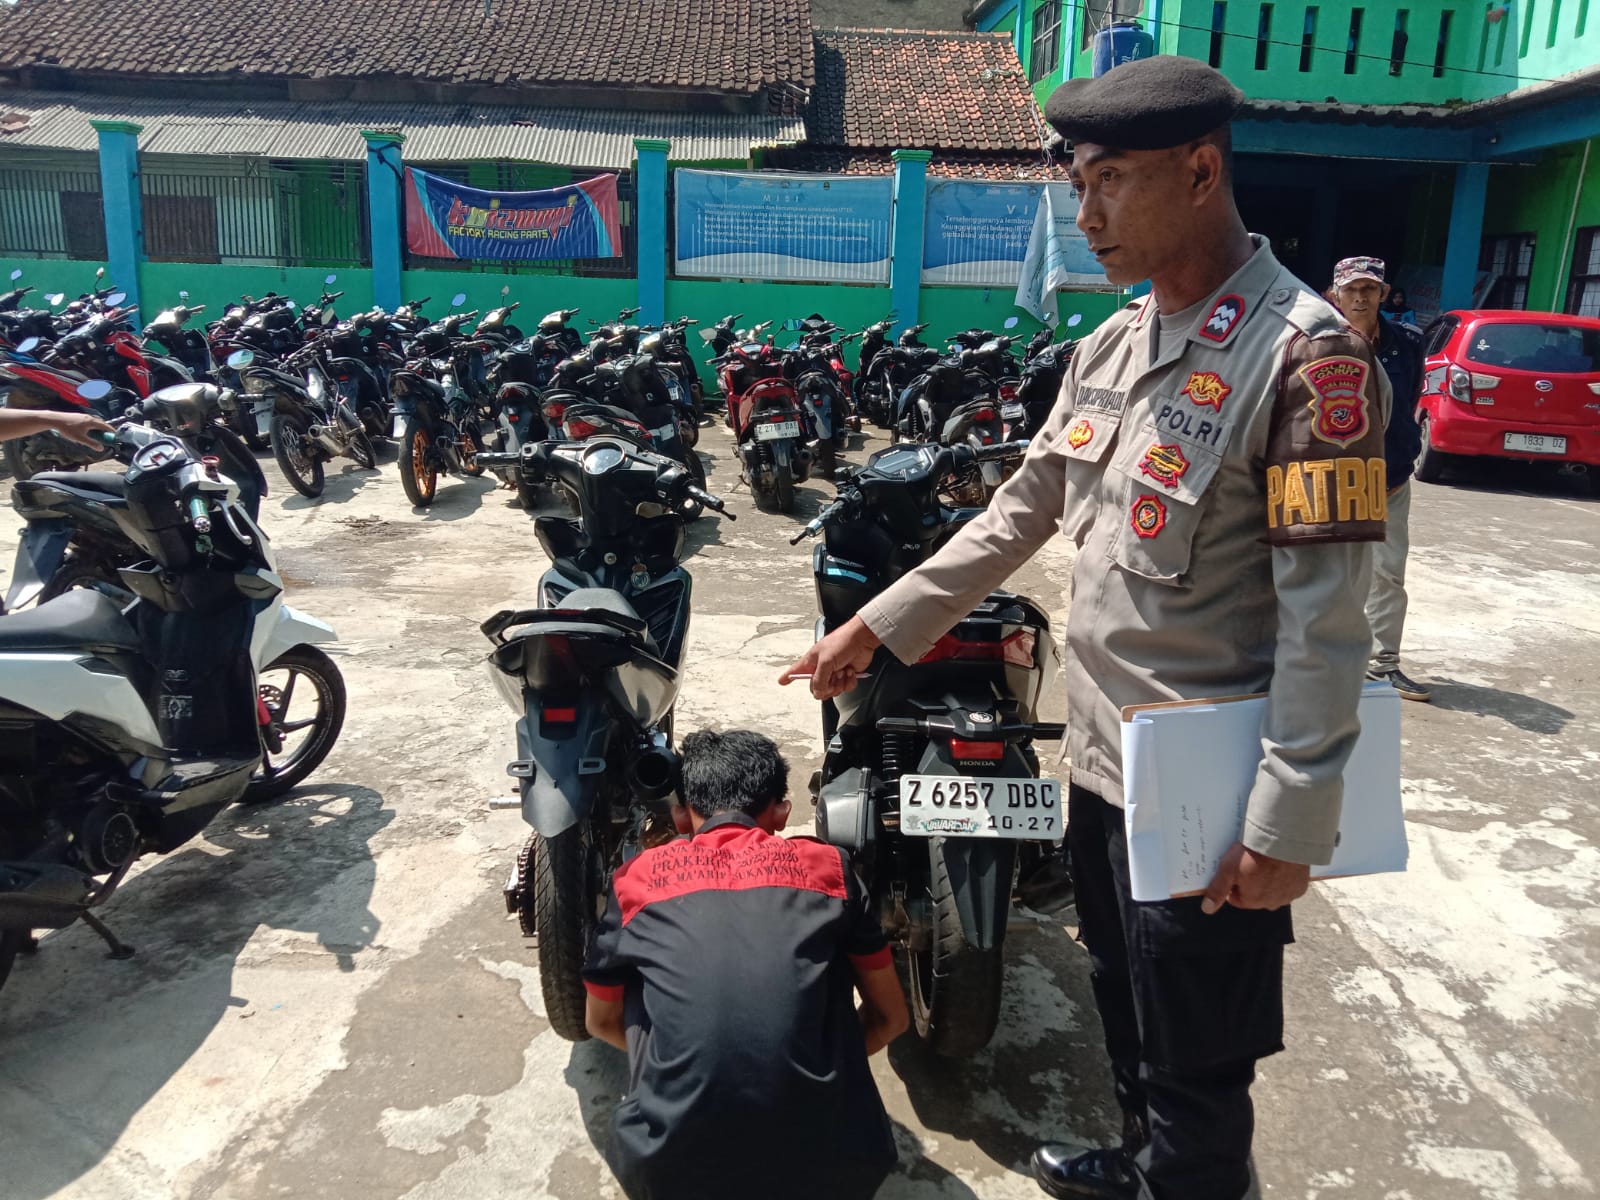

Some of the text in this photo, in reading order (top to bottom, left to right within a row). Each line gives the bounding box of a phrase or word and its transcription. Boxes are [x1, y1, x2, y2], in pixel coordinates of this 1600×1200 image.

[1006, 204, 1029, 216] VI
[448, 227, 549, 239] FACTORY RACING PARTS
[1155, 403, 1223, 447] POLRI
[1505, 433, 1512, 444] Z
[1523, 434, 1545, 447] 1833
[1266, 456, 1388, 529] PATRO
[908, 780, 1055, 808] Z 6257 DBC
[647, 875, 670, 892] SMK
